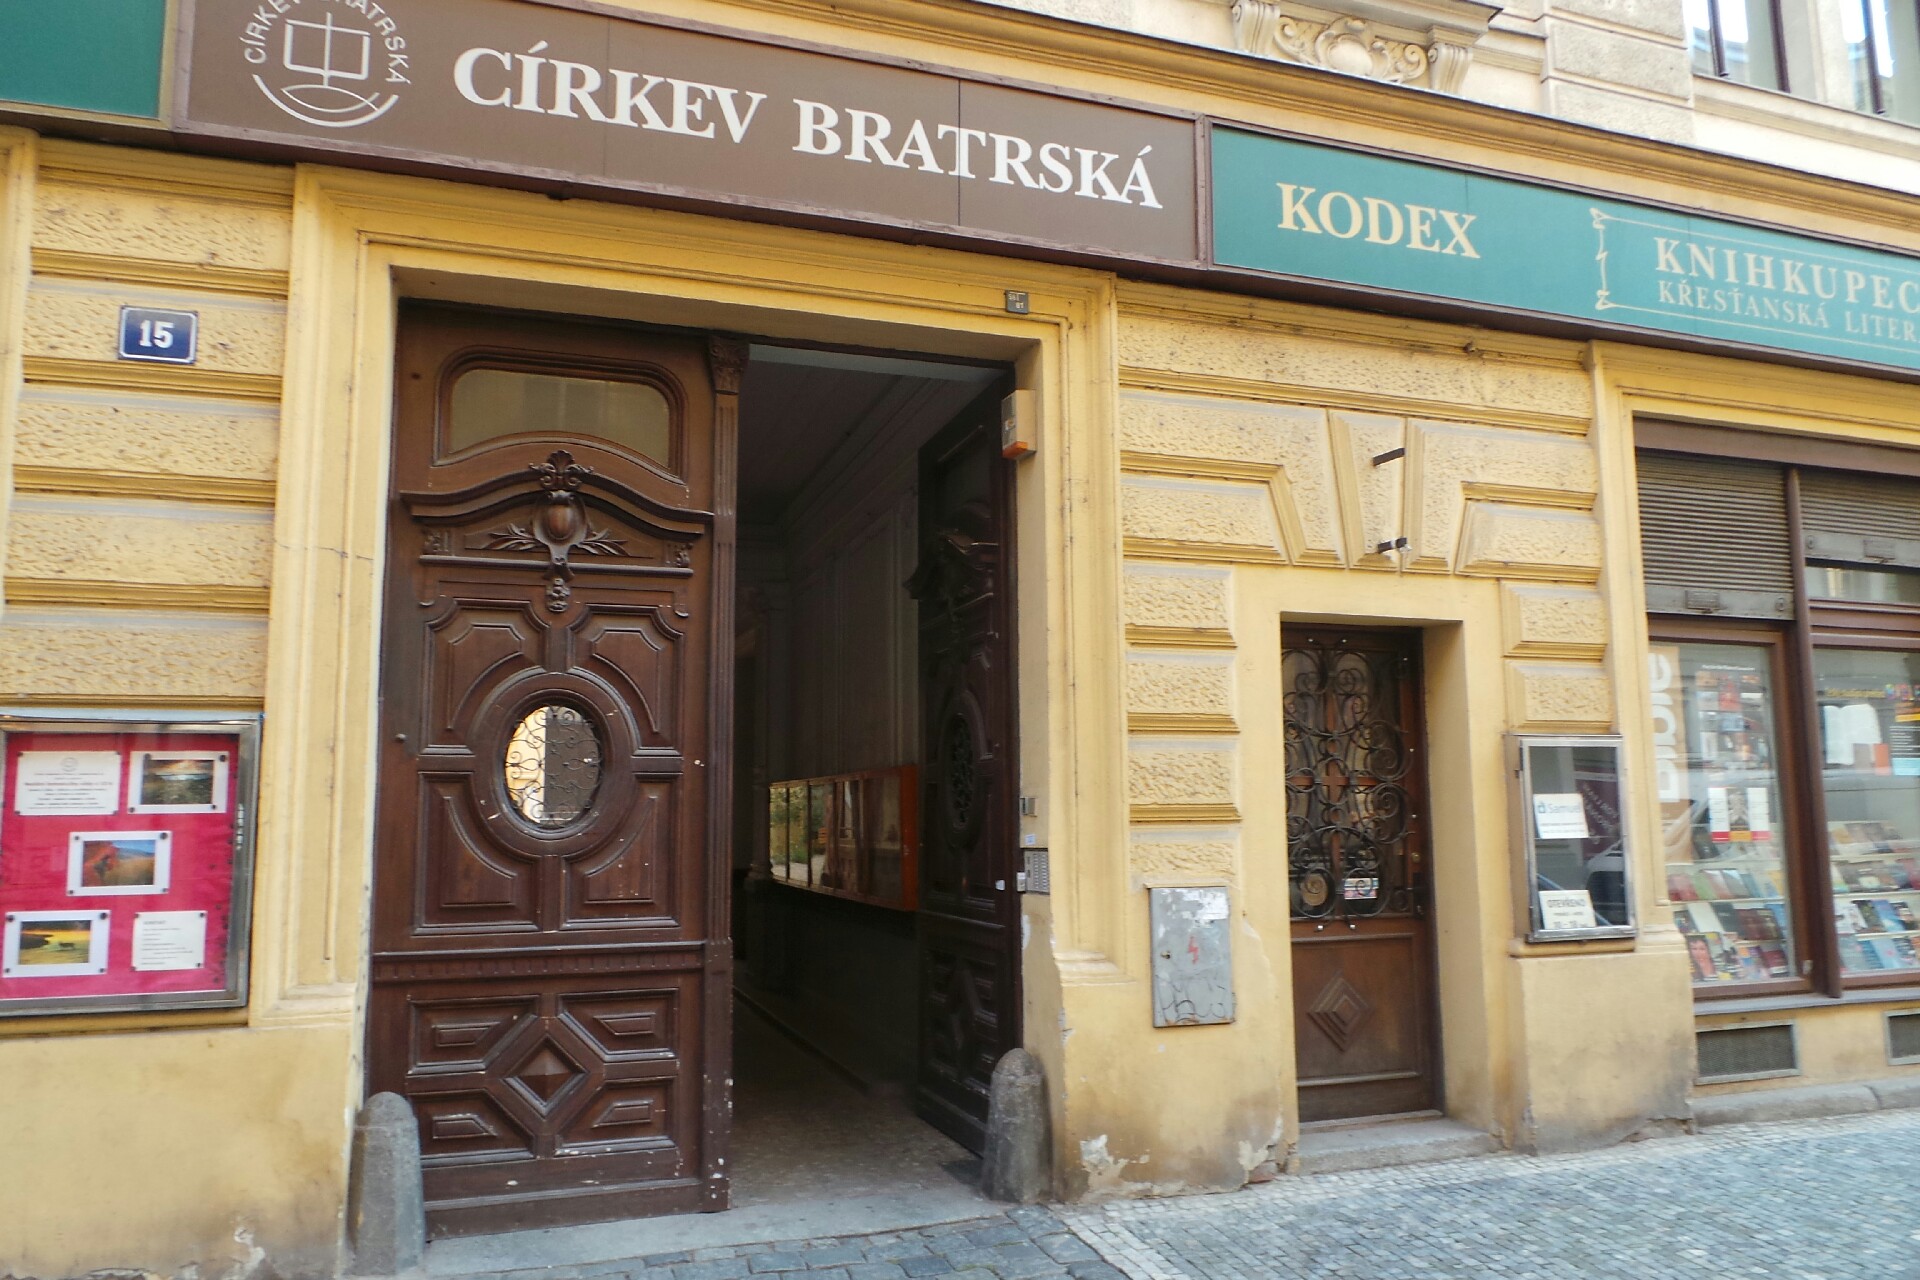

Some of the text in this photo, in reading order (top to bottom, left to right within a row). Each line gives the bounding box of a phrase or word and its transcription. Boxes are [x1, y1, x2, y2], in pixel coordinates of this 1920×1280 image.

[239, 0, 301, 64] CÍRKE
[453, 40, 1163, 209] CÍRKEV BRATRSKÁ
[1275, 182, 1482, 259] KODEX
[1653, 236, 1920, 314] KNIHKUPEC
[138, 319, 175, 349] 15
[1657, 279, 1920, 344] KŘESŤANSKÁ LITER
